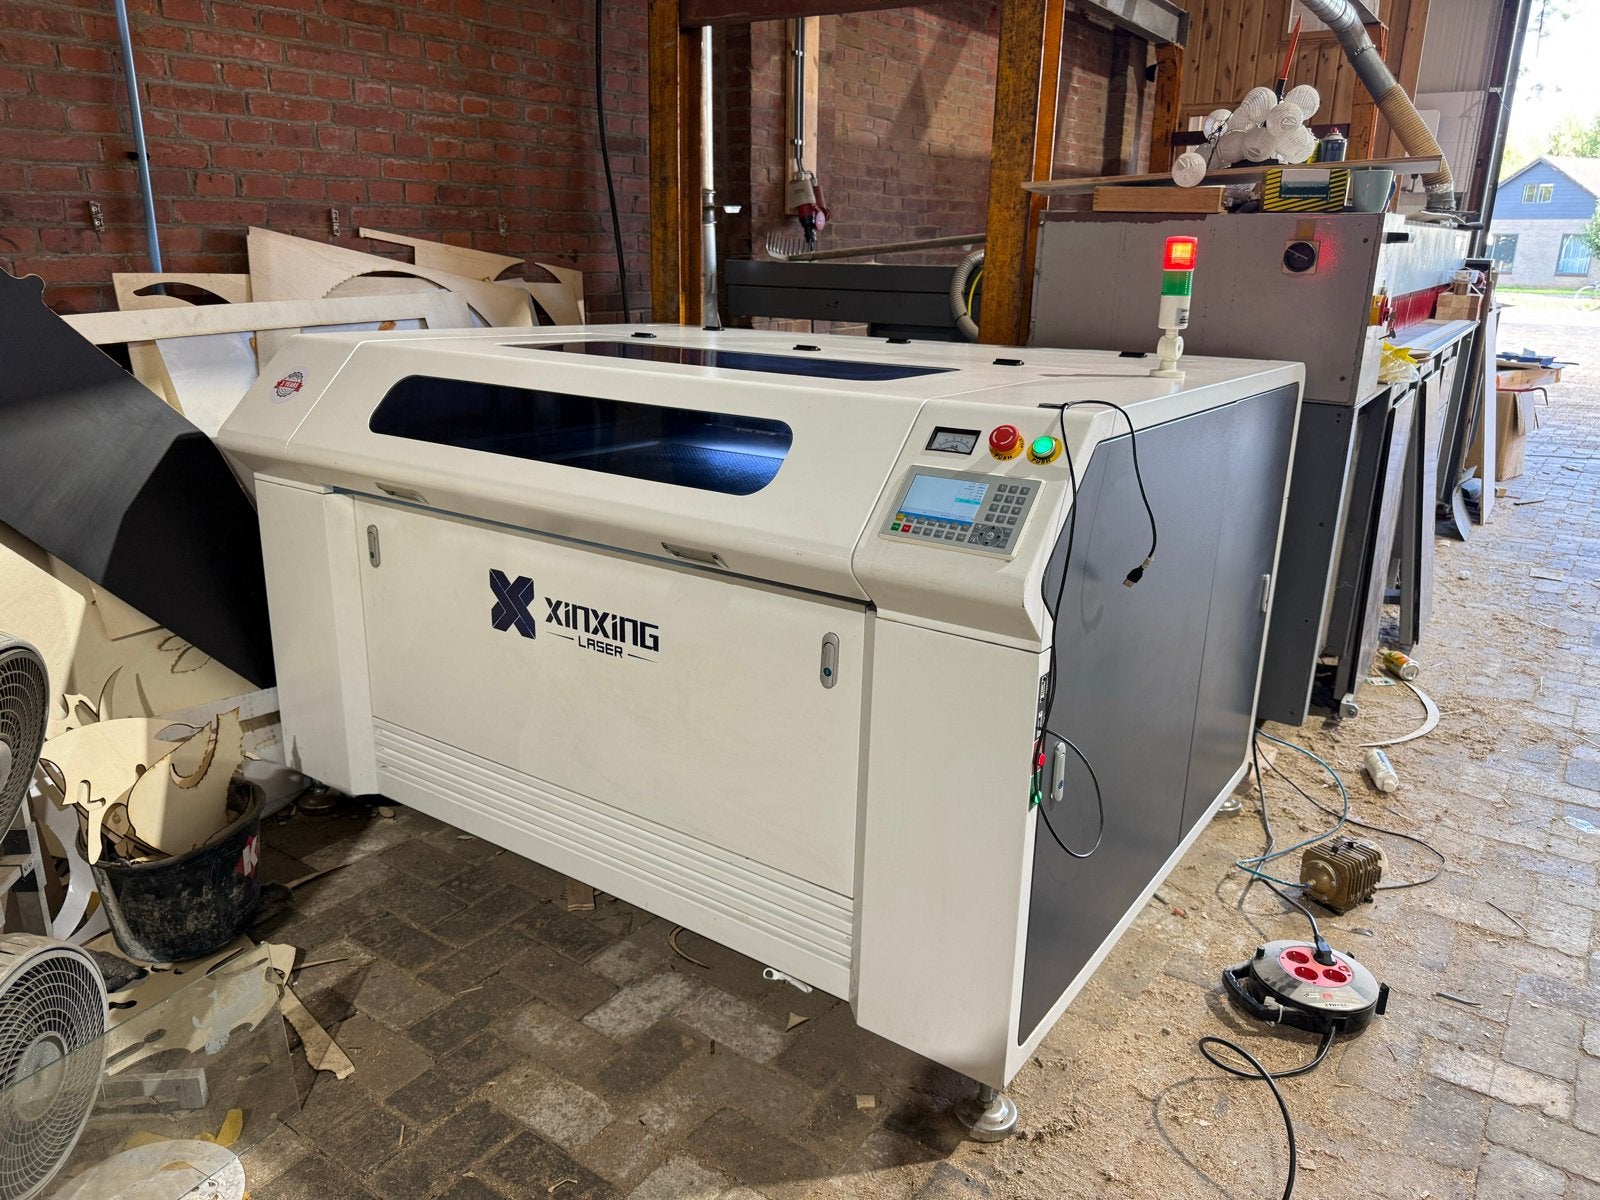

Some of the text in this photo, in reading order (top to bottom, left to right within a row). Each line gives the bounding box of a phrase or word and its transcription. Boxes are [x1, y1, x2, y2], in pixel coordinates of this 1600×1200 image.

[993, 453, 1013, 461] PUSH
[1031, 457, 1051, 465] PUSH
[578, 635, 623, 658] LASER
